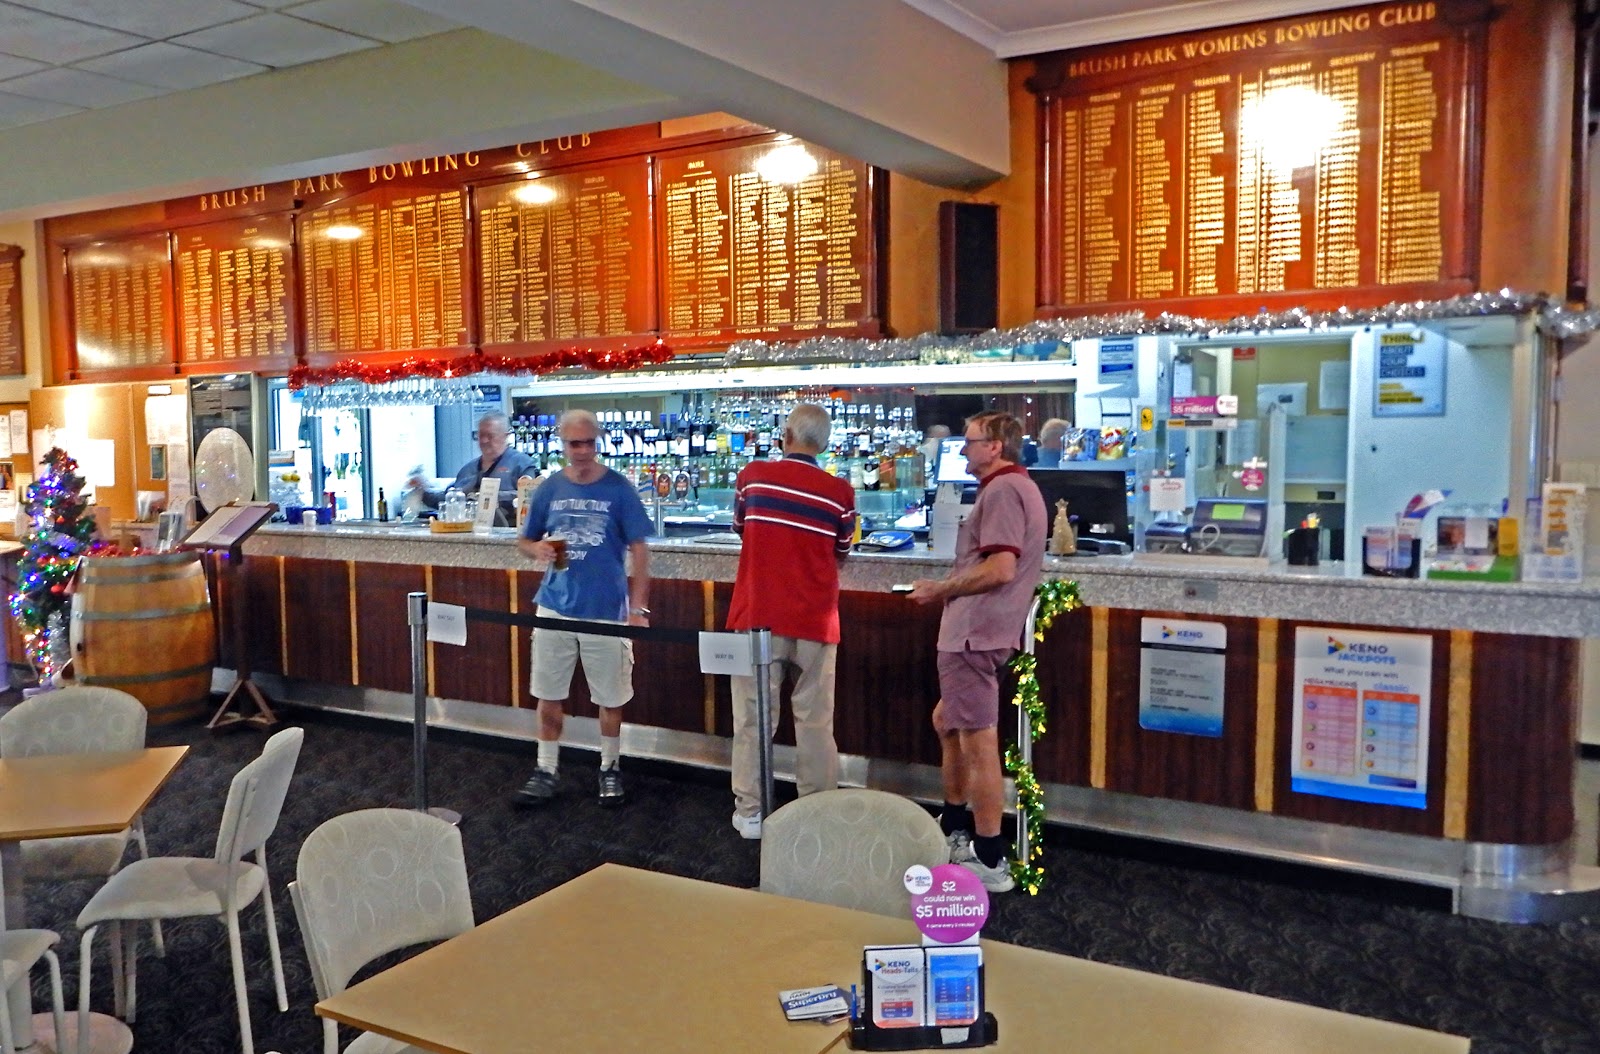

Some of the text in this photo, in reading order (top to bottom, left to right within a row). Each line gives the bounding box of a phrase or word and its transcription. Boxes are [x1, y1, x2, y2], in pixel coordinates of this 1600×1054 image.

[1068, 55, 1126, 77] BRUSH
[1132, 46, 1177, 67] PARK
[1275, 12, 1370, 44] BOWLING
[1379, 2, 1436, 28] CLUB
[200, 132, 591, 211] BRUSH PARK BOWLING CLUB
[552, 501, 567, 511] NO
[1177, 630, 1203, 639] KENO
[1349, 643, 1388, 655] KENO
[1338, 653, 1396, 665] JACKPOTS
[1347, 669, 1363, 677] you
[1383, 671, 1398, 679] win
[942, 881, 956, 892] $2
[924, 894, 945, 902] could
[963, 894, 976, 902] win
[916, 903, 984, 919] $5 million!
[887, 960, 911, 968] KENO
[788, 991, 837, 1009] SuperDry
